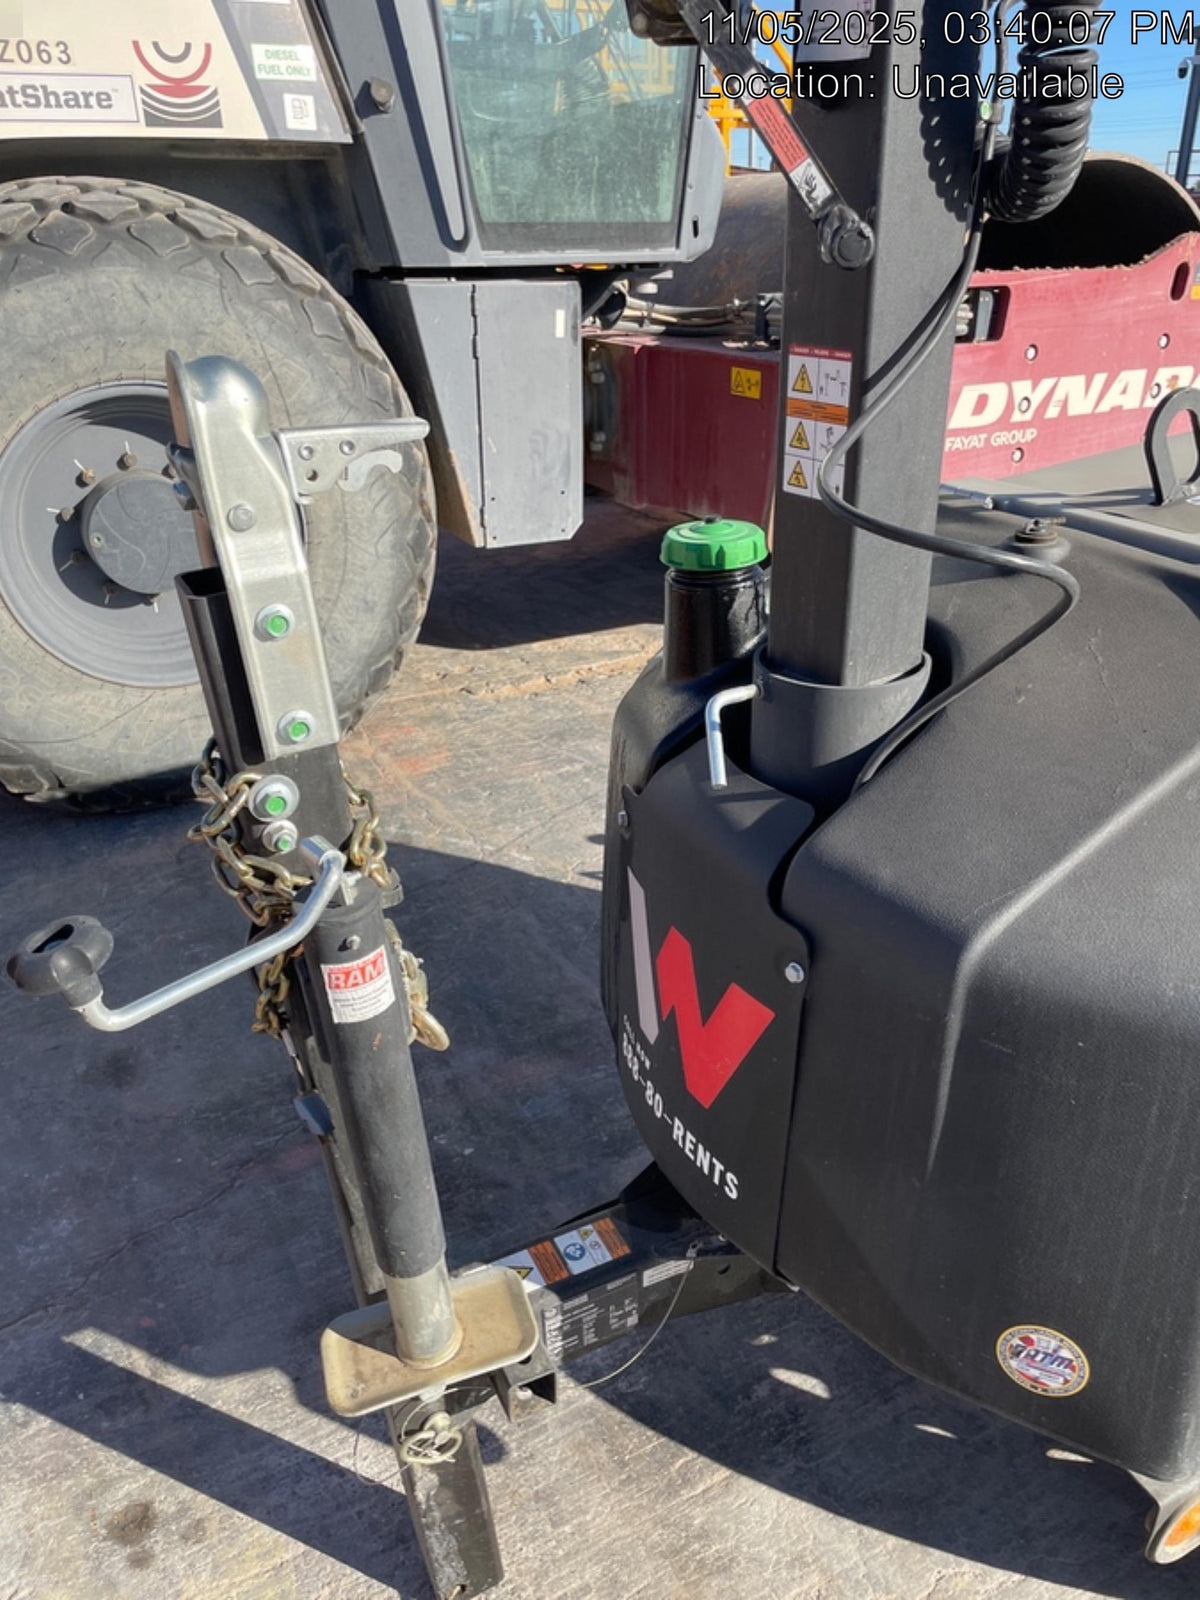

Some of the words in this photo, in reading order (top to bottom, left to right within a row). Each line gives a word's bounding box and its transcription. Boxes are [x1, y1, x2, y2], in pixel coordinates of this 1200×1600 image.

[264, 49, 299, 60] DIESEL
[257, 63, 284, 75] FUEL
[286, 65, 311, 77] ONLY
[944, 433, 988, 452] FAYAT
[990, 428, 1038, 447] GROUP
